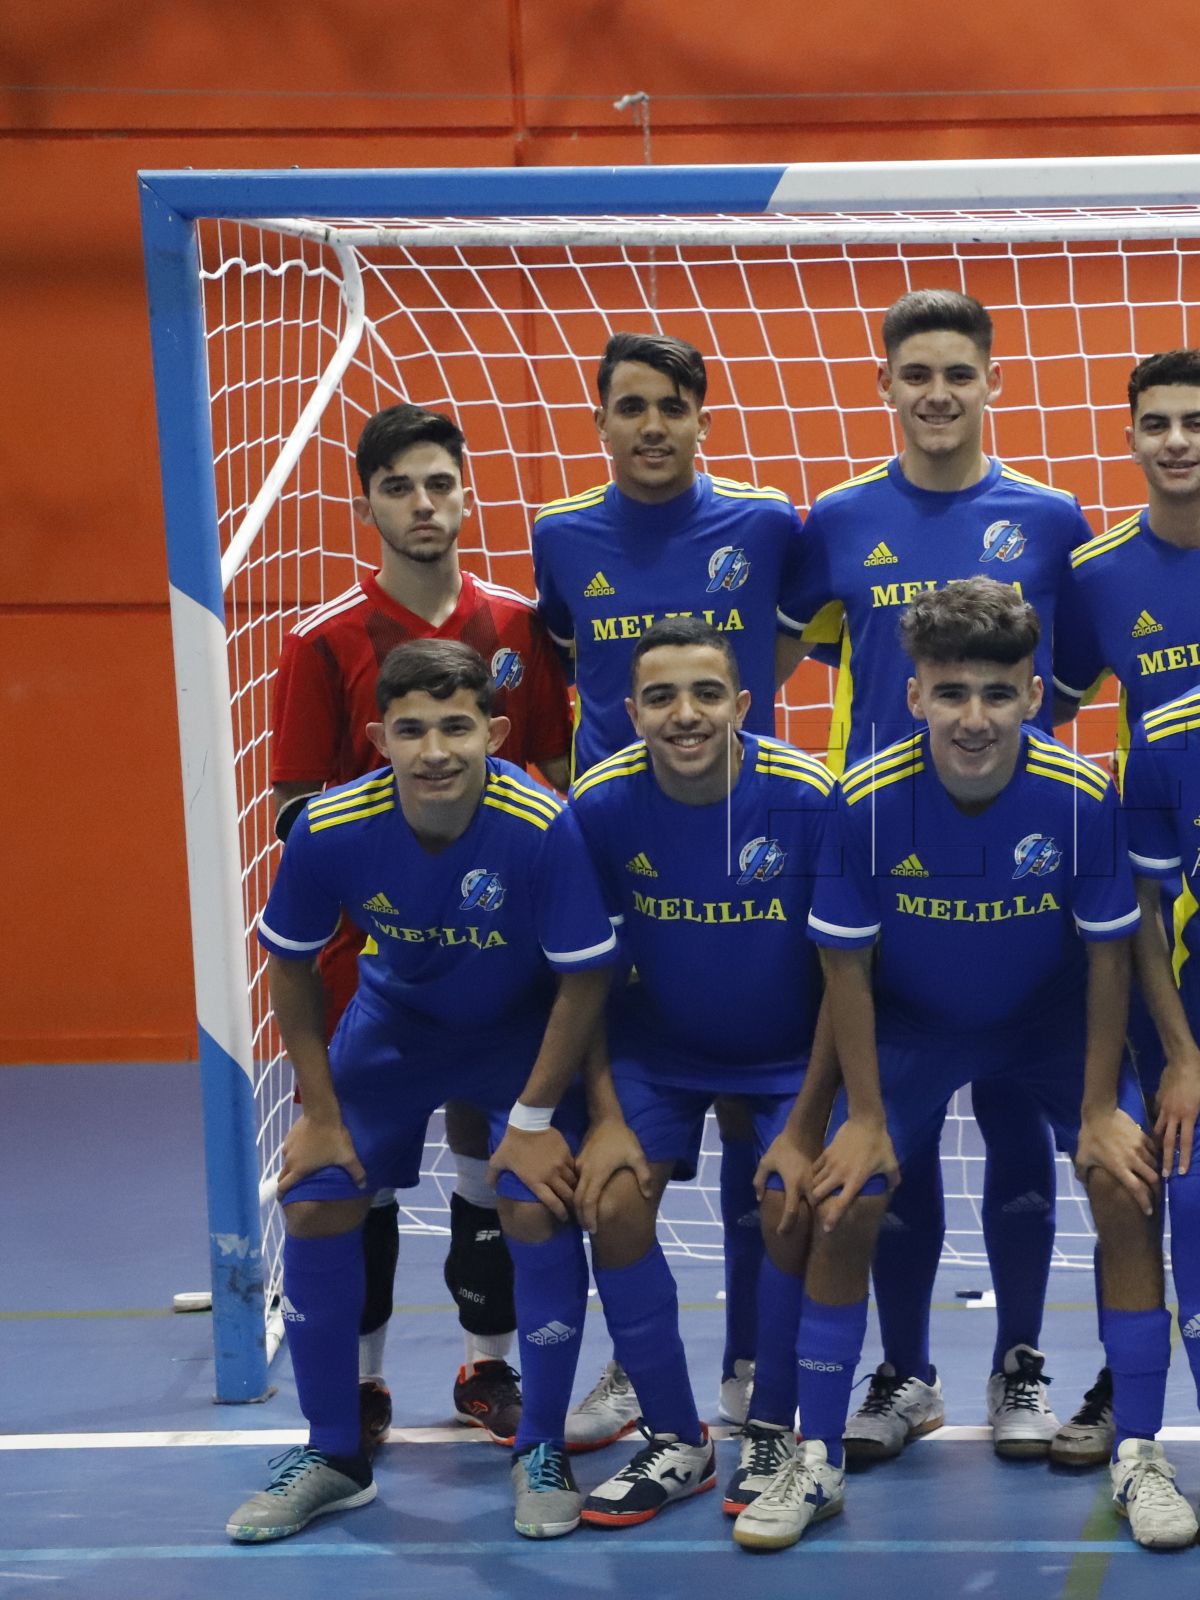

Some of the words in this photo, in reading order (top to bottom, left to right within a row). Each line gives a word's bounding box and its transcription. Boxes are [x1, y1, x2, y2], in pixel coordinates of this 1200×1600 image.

[864, 556, 898, 567] adidas
[584, 587, 615, 597] adidas
[1132, 623, 1163, 638] adidas
[890, 868, 929, 878] adidas
[362, 903, 399, 915] adidas
[633, 891, 787, 923] MELILLA
[896, 892, 1060, 923] MELILLA
[458, 1287, 486, 1304] JORGE
[798, 1358, 843, 1373] adidas
